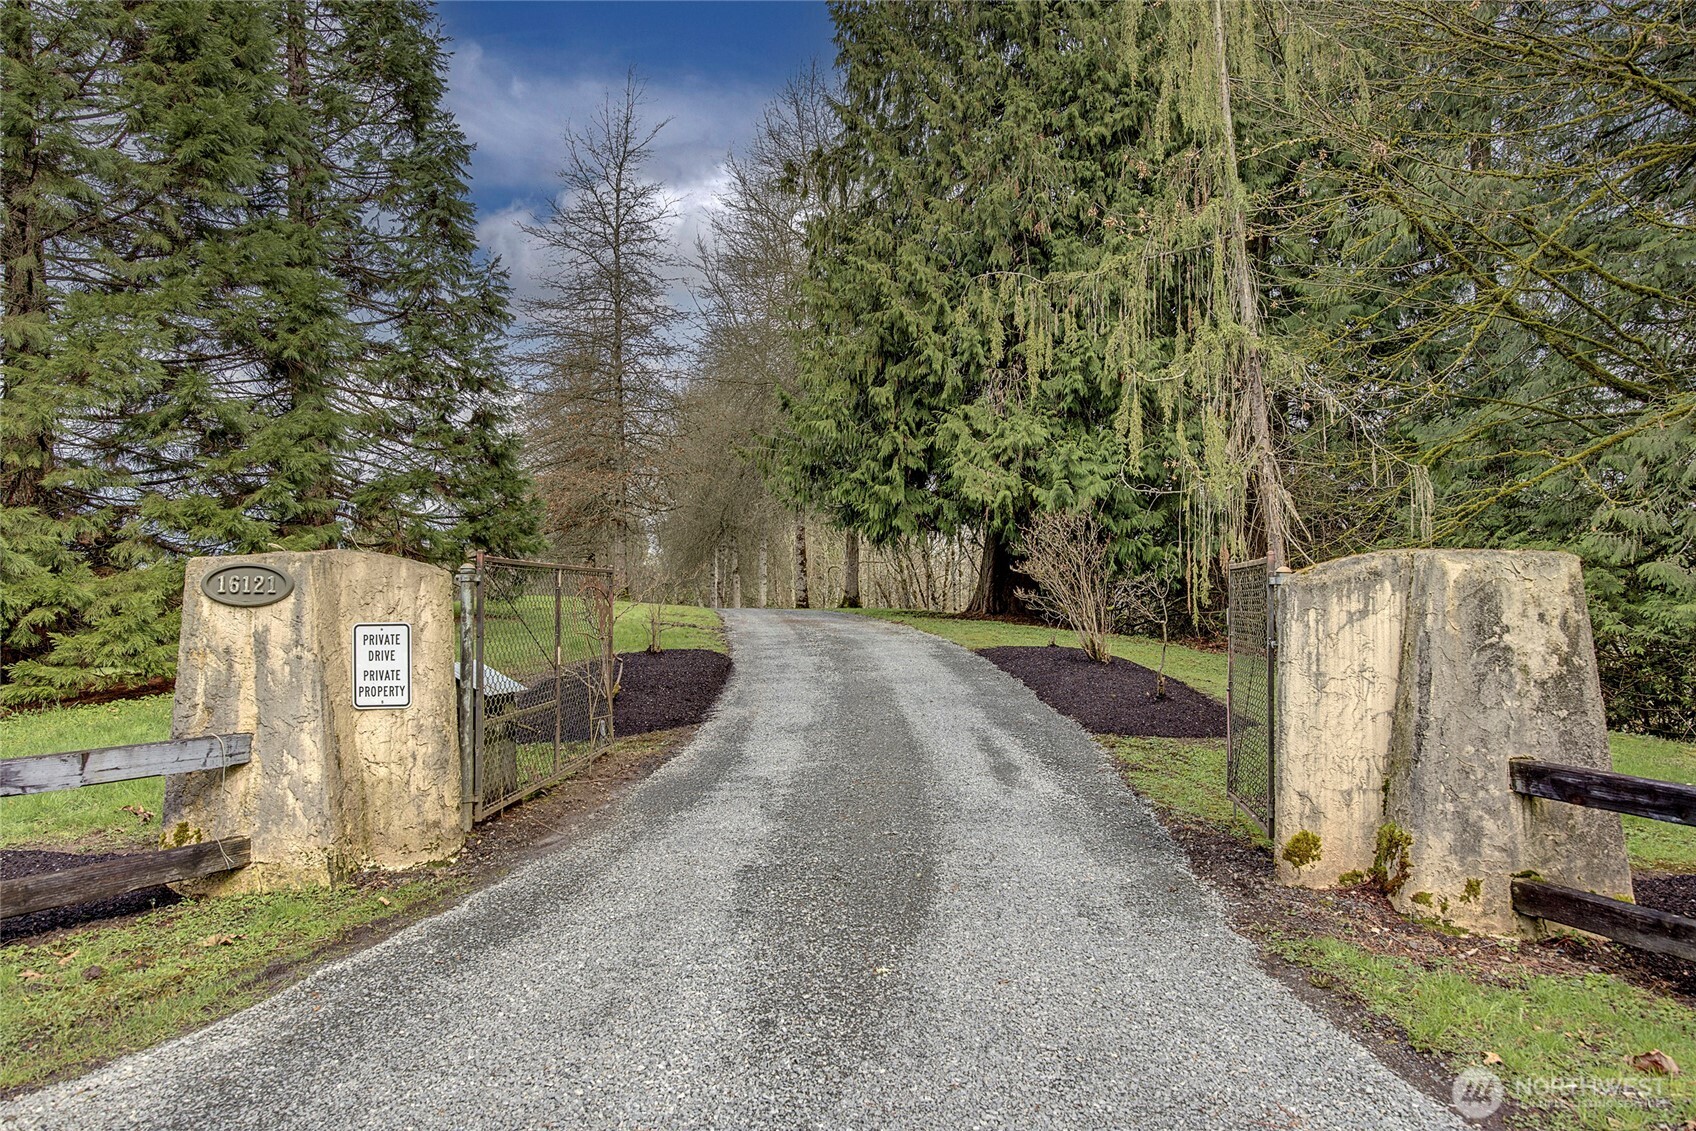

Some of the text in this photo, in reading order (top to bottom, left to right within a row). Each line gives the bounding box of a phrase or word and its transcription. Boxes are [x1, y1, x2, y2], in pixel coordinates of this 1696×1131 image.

[217, 575, 276, 594] 16121
[363, 634, 401, 646] PRIVATE
[368, 650, 395, 662] DRIVE
[363, 670, 401, 681] PRIVATE
[358, 685, 405, 698] PROPERTY
